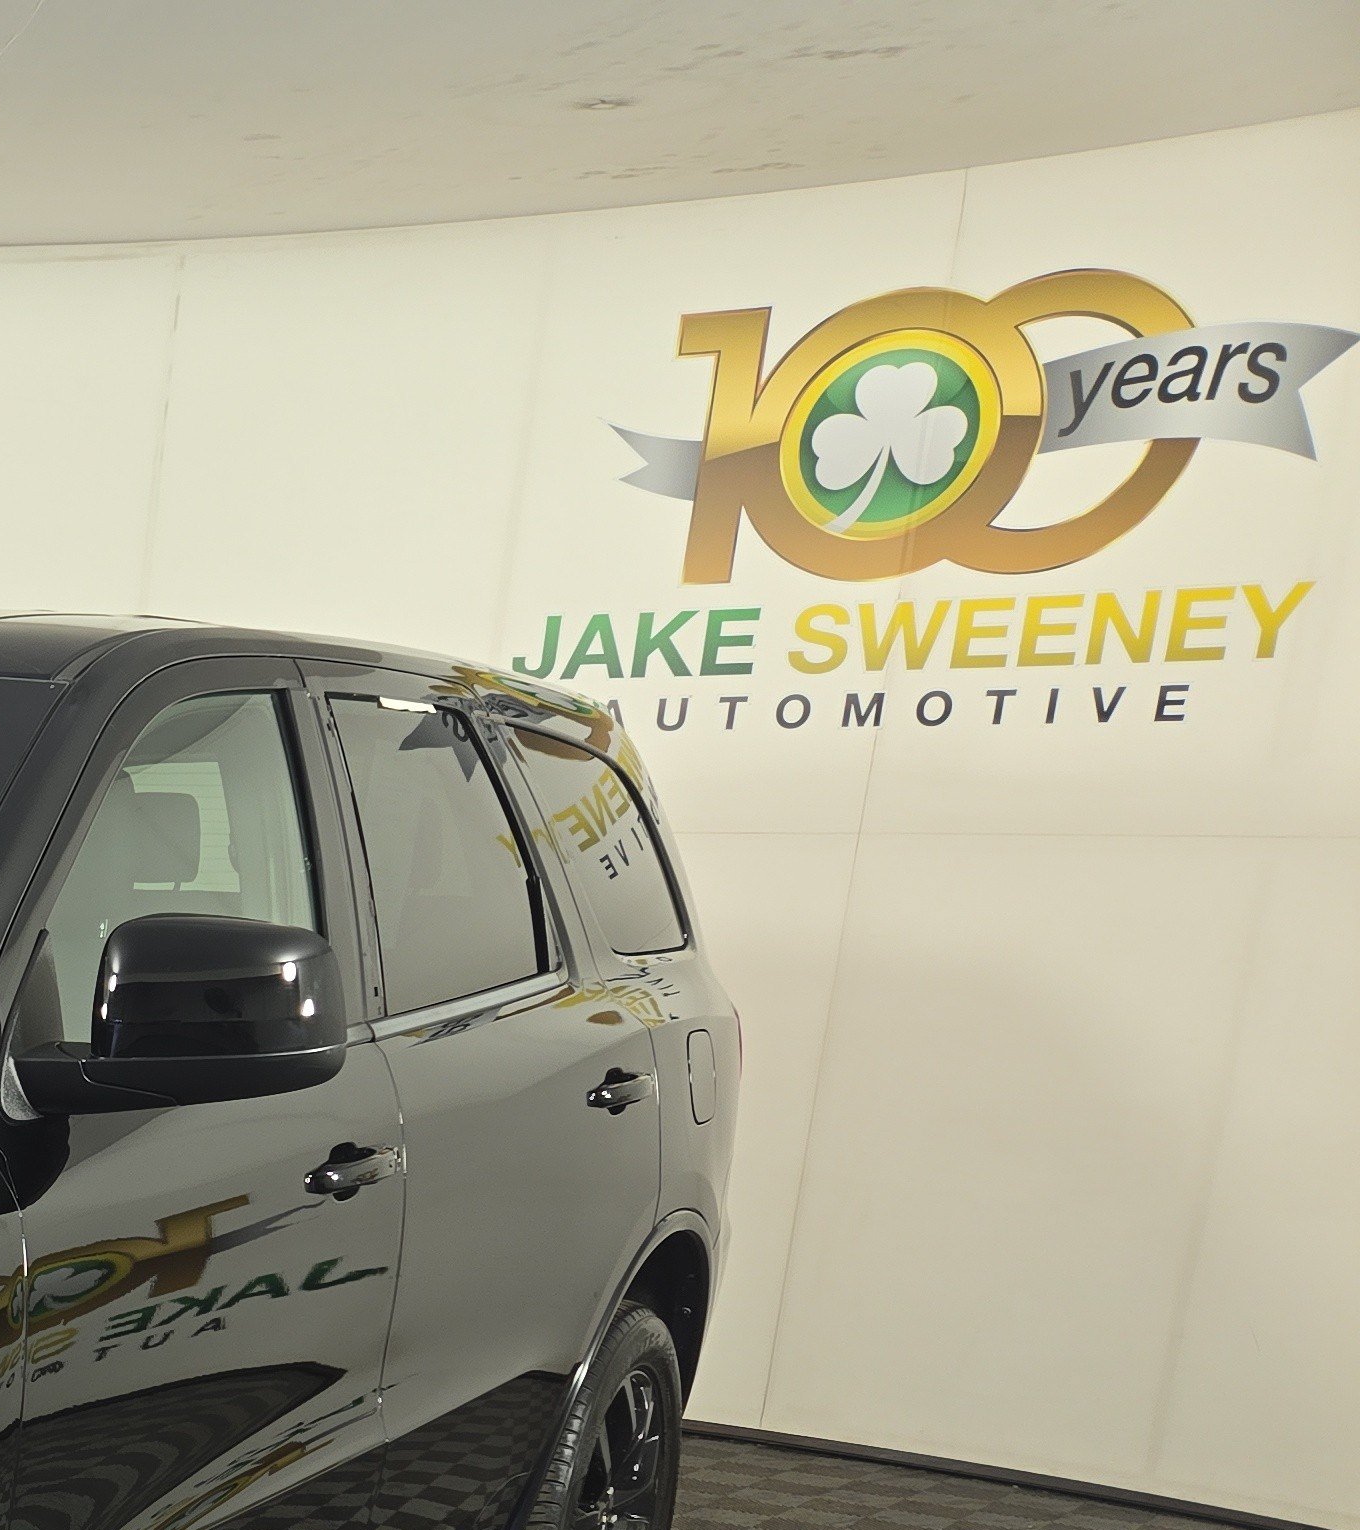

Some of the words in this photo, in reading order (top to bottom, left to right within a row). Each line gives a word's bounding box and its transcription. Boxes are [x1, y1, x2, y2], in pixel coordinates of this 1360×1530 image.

[678, 267, 1203, 585] 100
[1057, 340, 1287, 438] years
[511, 607, 762, 680] JAKE
[786, 580, 1316, 675] SWEENEY
[605, 684, 1191, 732] AUTOMOTIVE
